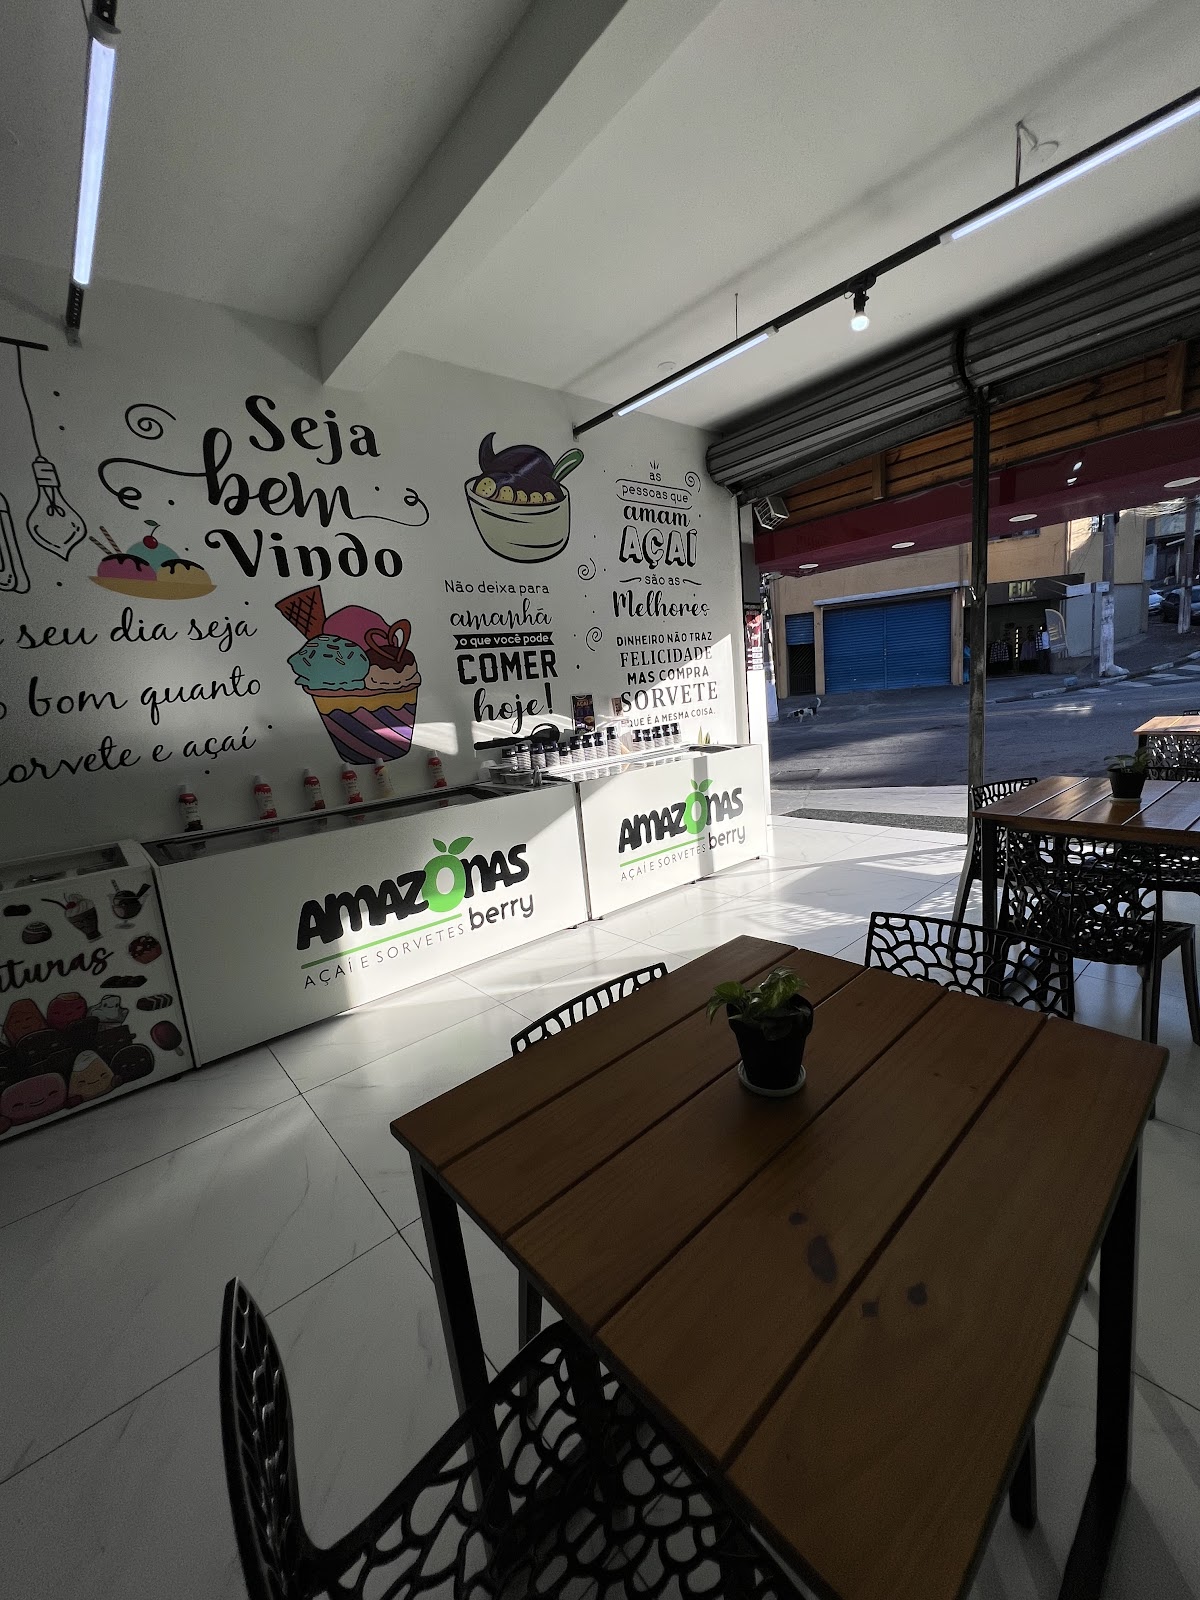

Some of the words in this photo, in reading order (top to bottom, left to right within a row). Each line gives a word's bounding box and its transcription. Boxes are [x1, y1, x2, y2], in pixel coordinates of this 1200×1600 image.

[245, 395, 381, 465] Seja
[200, 427, 430, 528] bem
[649, 472, 662, 481] as
[621, 484, 668, 500] pessoas
[670, 492, 689, 504] que
[623, 505, 691, 527] amam
[204, 529, 403, 581] Vindo
[619, 525, 698, 570] AÇAÍ
[444, 579, 474, 593] Não
[477, 580, 517, 593] deixa
[519, 584, 550, 597] para
[644, 573, 666, 586] são
[667, 576, 681, 586] as
[450, 598, 552, 630] amanhã
[613, 590, 709, 617] Melhores
[16, 624, 98, 650] seu
[110, 606, 178, 642] dia
[187, 616, 258, 653] seja
[459, 638, 468, 646] o
[469, 637, 491, 648] que
[493, 633, 521, 645] você
[522, 632, 549, 646] pode
[616, 634, 665, 646] DINHEIRO
[666, 631, 688, 644] NÃO
[689, 631, 713, 641] TRAZ
[456, 649, 559, 685] COMER
[619, 645, 713, 668] FELICIDADE
[627, 670, 656, 686] MAS
[658, 665, 710, 682] COMPRA
[28, 676, 128, 717] bom
[140, 665, 261, 726] quanto
[473, 682, 553, 735] hoje!
[620, 681, 717, 712] SORVETE
[646, 714, 652, 725] É
[654, 715, 660, 724] A
[661, 710, 690, 723] MESMA
[690, 706, 716, 718] COISA.
[0, 735, 141, 786] orvete
[152, 744, 173, 762] e
[183, 726, 257, 760] açaí
[708, 826, 746, 850] berry
[620, 861, 646, 881] AÇAÍ
[649, 861, 655, 871] E
[658, 843, 706, 869] SORVETES
[468, 894, 535, 931] berry
[304, 957, 354, 990] AÇAÍ
[360, 956, 370, 969] E
[376, 924, 464, 963] SORVETES
